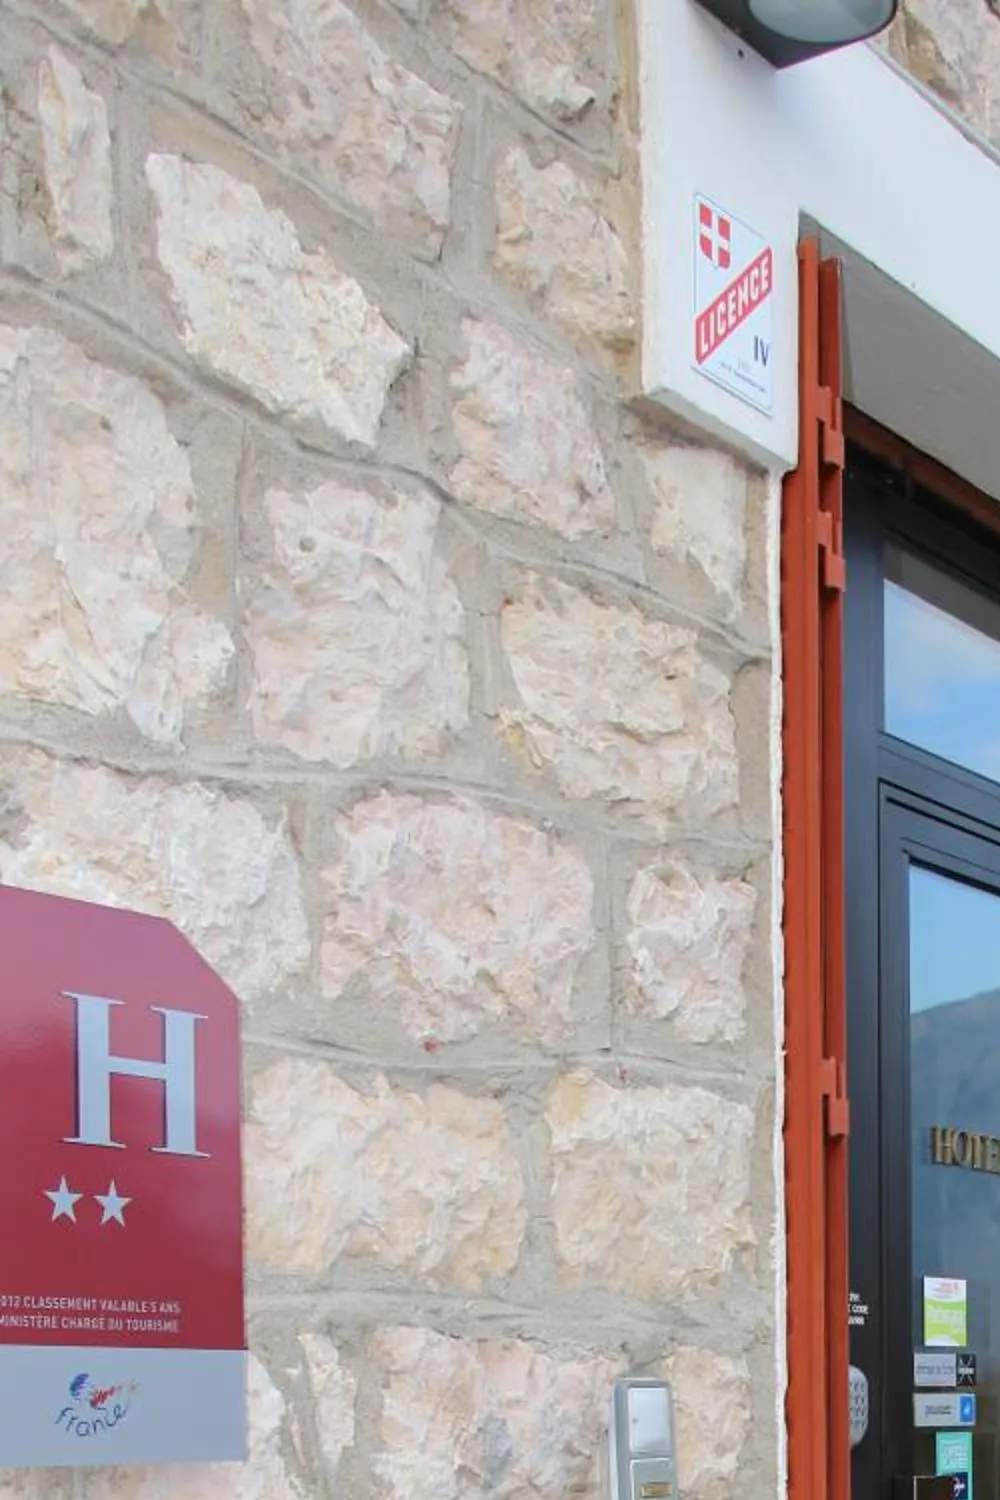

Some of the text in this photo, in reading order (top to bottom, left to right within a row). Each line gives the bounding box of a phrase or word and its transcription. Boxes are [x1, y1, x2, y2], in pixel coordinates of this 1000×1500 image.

[699, 256, 770, 356] LICENCE
[753, 335, 769, 367] IV
[61, 991, 211, 1159] H
[24, 1296, 97, 1311] CLASSEMENT
[100, 1300, 148, 1313] VALABLE
[159, 1301, 181, 1314] ANS
[107, 1317, 123, 1331] DU
[125, 1318, 179, 1333] TOURISME
[54, 1402, 130, 1437] France
